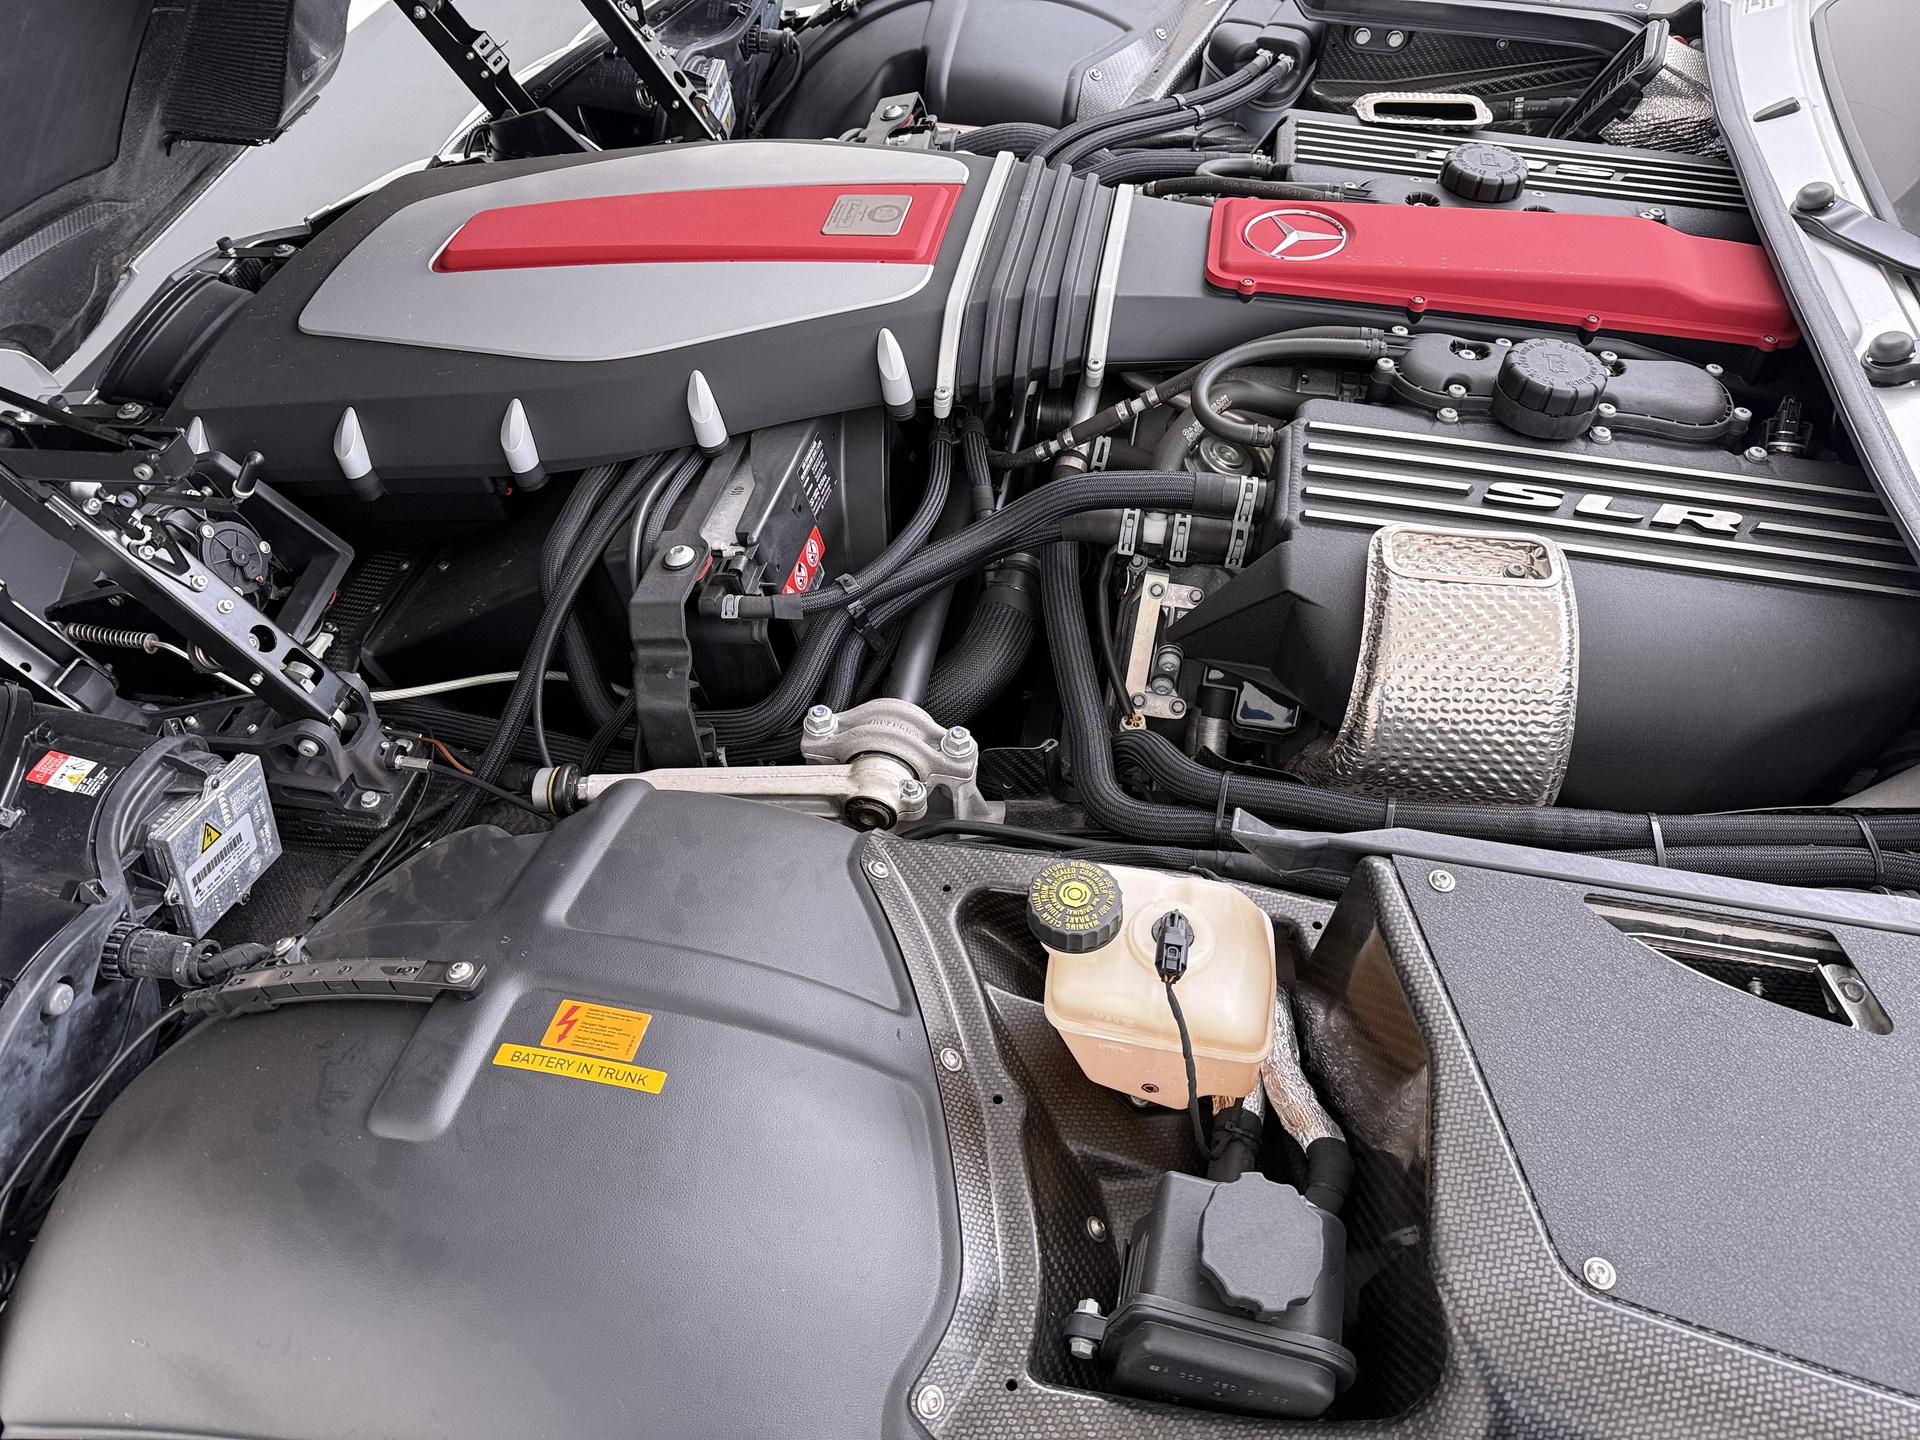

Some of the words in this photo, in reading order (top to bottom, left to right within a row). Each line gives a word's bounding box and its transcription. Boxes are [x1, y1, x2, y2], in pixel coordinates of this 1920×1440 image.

[1482, 482, 1744, 535] SLR
[1041, 862, 1066, 878] BEFORE
[1052, 867, 1076, 878] SEALED
[1070, 861, 1105, 877] REMOVING
[1032, 878, 1042, 890] CAP
[1079, 868, 1108, 894] CONTAINER
[1031, 892, 1043, 911] FILLER
[1040, 885, 1049, 902] FROM
[1044, 903, 1062, 918] FLUID
[1042, 913, 1062, 928] CLEAN
[1065, 915, 1090, 923] BRAKE
[1065, 920, 1100, 931] WARNING
[510, 1050, 576, 1071] BATTERY
[576, 1062, 594, 1075] IN
[598, 1065, 648, 1086] TRUNK
